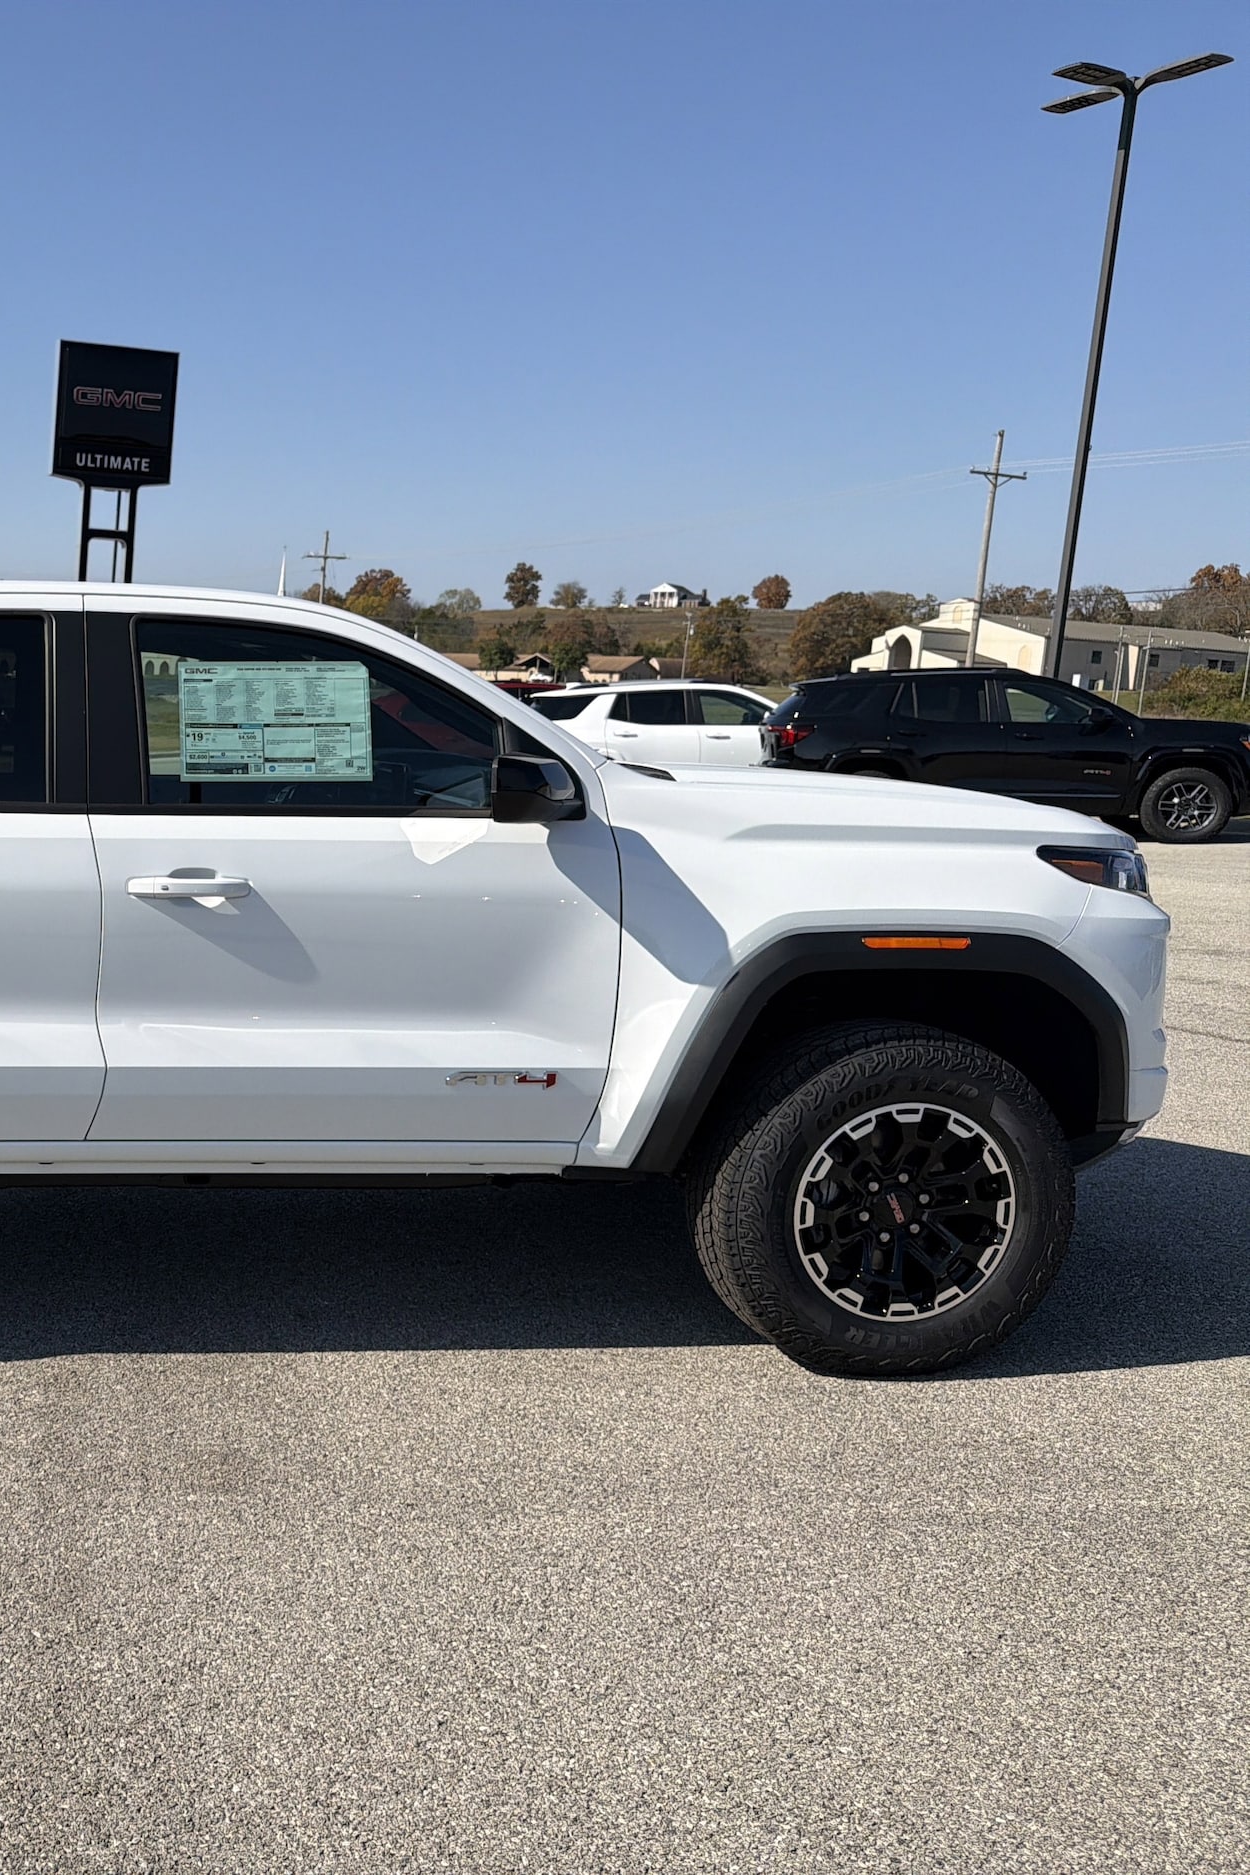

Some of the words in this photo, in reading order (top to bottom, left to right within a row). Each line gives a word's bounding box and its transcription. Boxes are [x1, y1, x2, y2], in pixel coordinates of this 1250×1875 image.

[73, 386, 162, 411] GMC
[76, 452, 150, 472] ULTIMATE
[191, 732, 204, 741] 19
